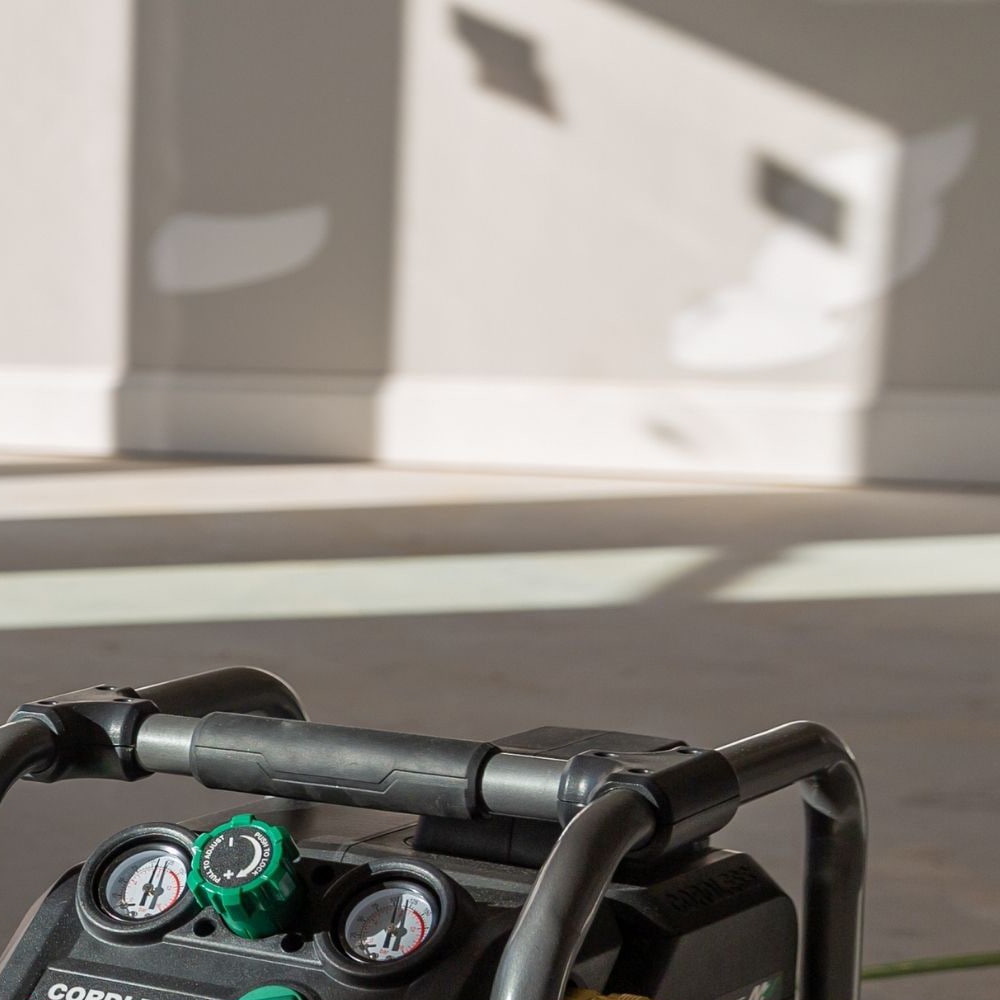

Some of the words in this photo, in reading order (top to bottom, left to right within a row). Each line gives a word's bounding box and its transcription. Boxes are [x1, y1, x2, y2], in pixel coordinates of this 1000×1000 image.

[204, 834, 225, 859] ADJUST
[254, 831, 270, 848] PUSH
[263, 848, 271, 857] TO
[203, 860, 211, 870] TO
[252, 858, 269, 877] LOCK
[206, 868, 221, 884] PULL
